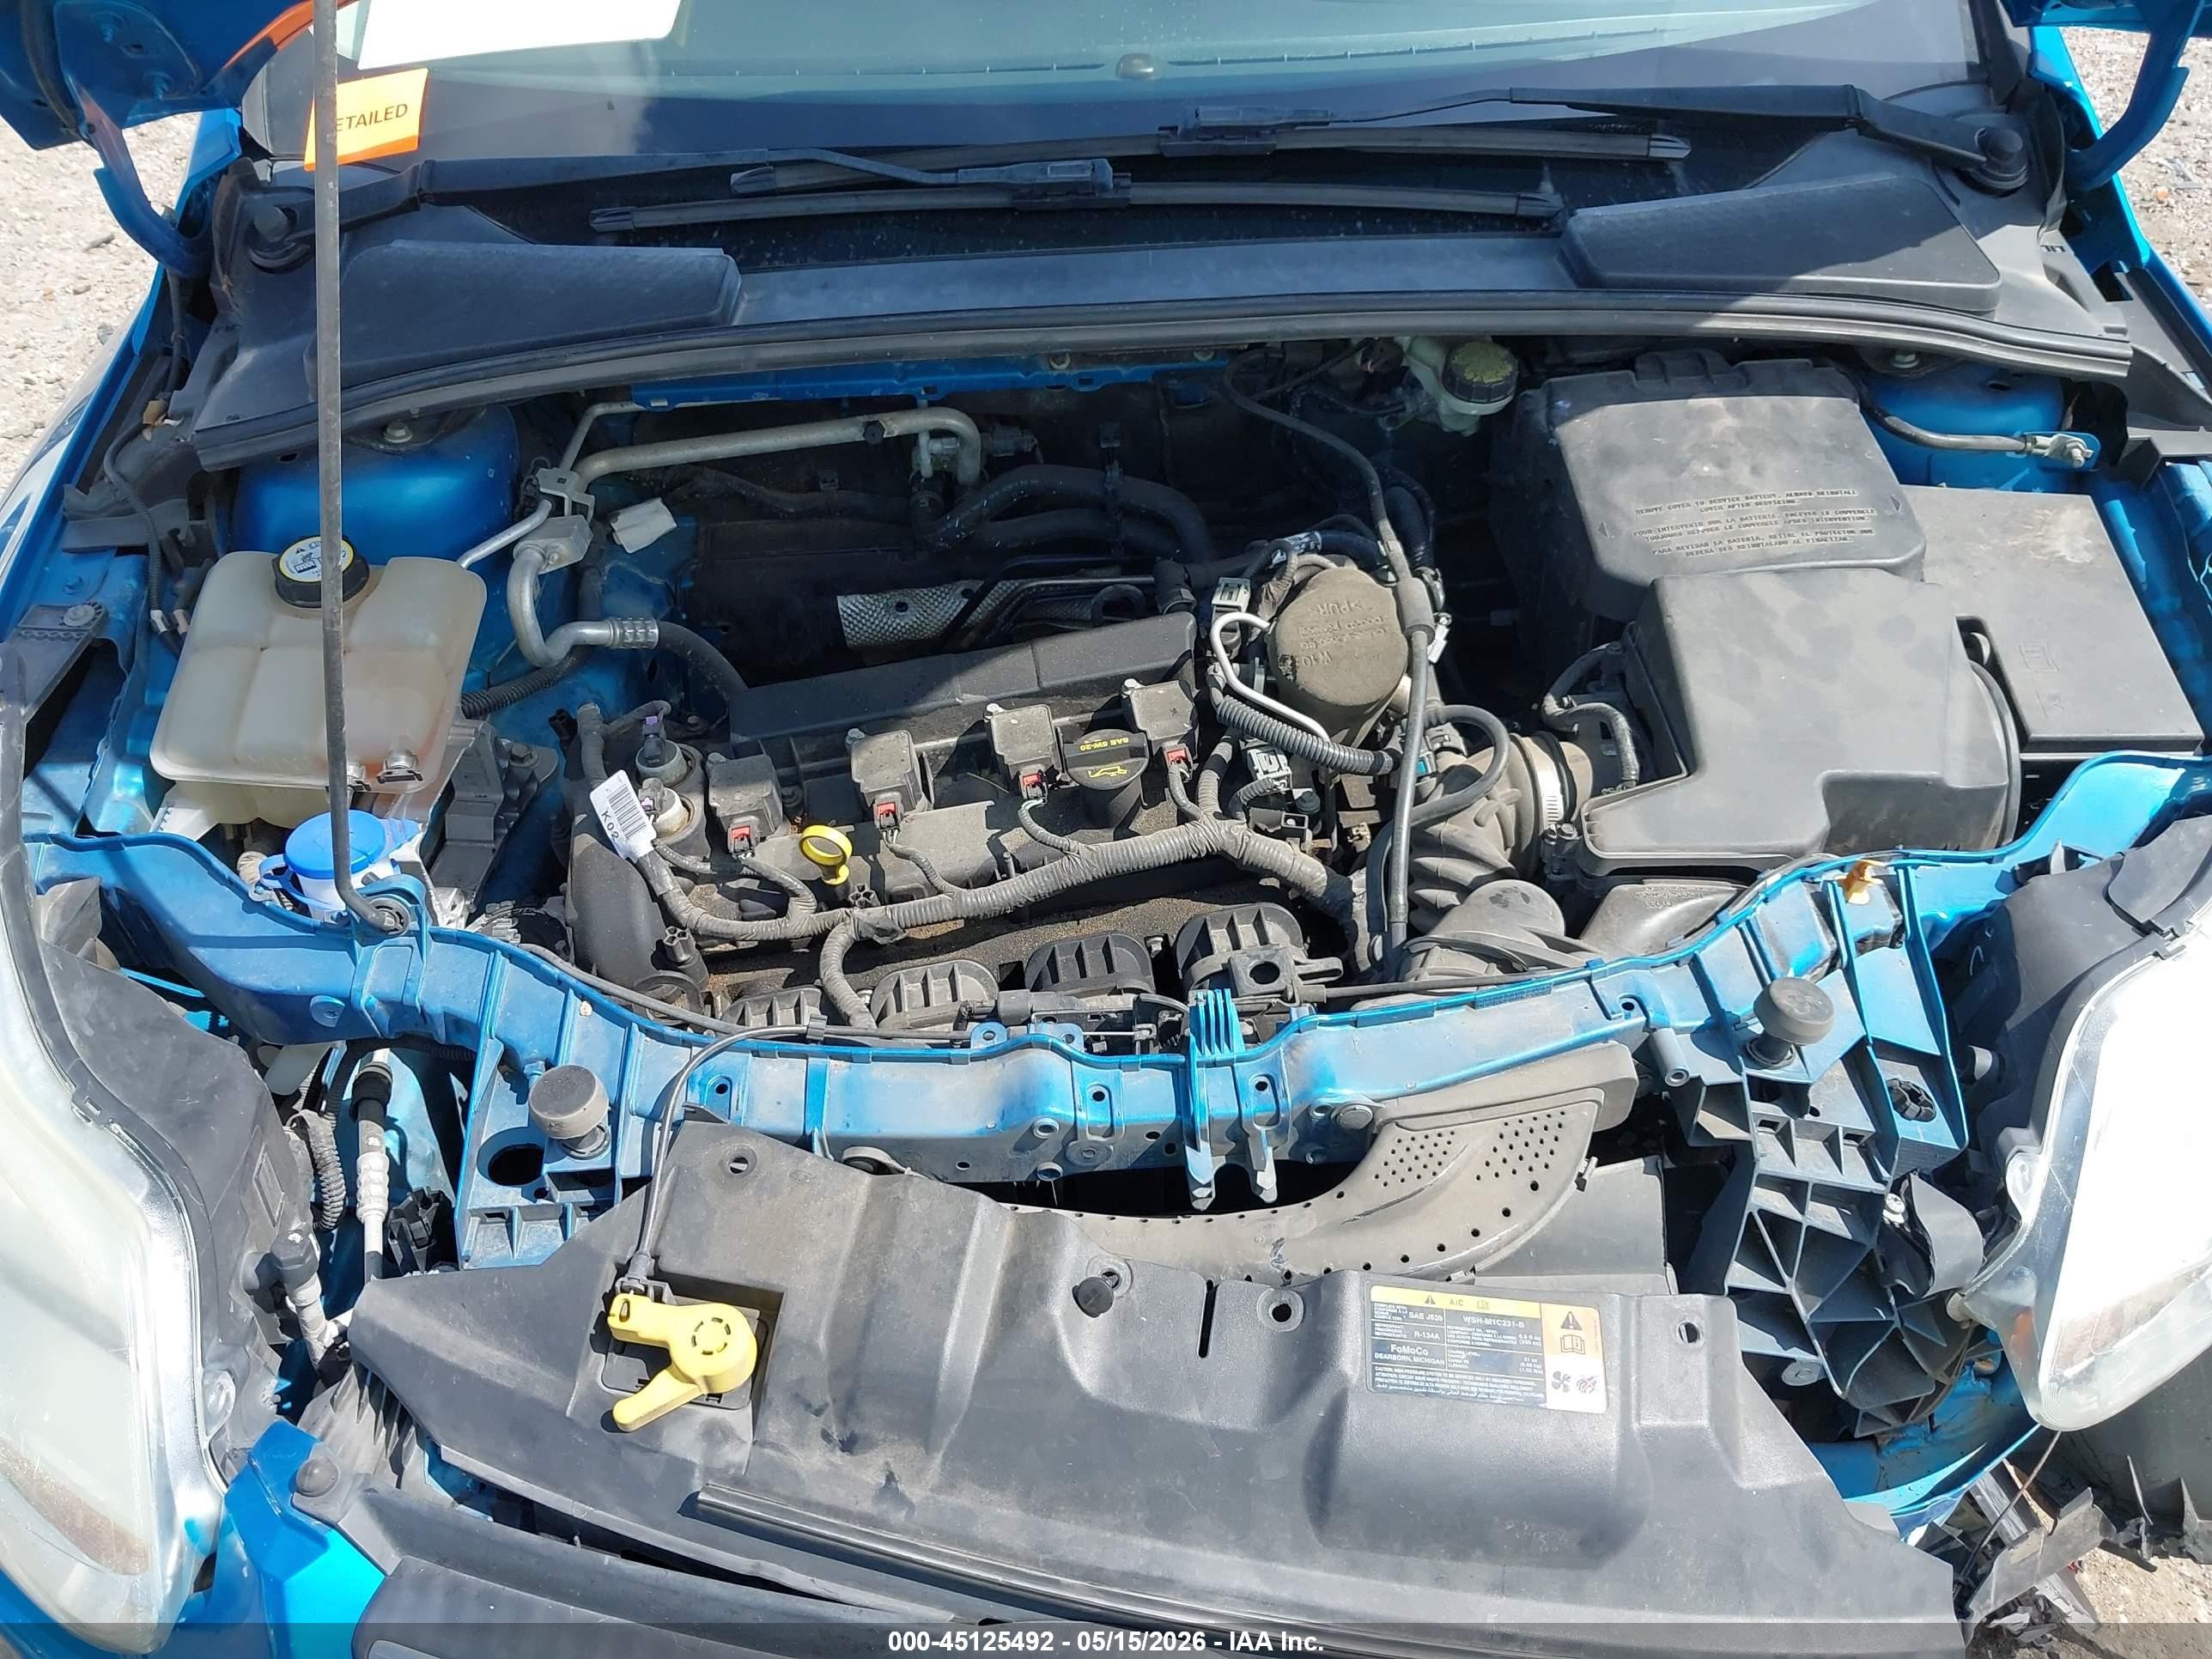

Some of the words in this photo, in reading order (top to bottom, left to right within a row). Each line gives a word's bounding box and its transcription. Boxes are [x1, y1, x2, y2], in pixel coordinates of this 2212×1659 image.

[336, 103, 409, 131] ETAILED
[1635, 505, 1663, 515] REMOVE
[1709, 496, 1740, 505] SERVICE
[1633, 528, 1653, 537] POUR
[1079, 742, 1108, 750] 5W-20
[1110, 738, 1128, 746] SAE
[601, 810, 619, 842] K02
[1449, 1297, 1464, 1306] A/C
[1408, 1311, 1424, 1320] SAE
[1462, 1315, 1525, 1328] WSH-M1C231-B
[1413, 1331, 1440, 1340] R-134A
[1390, 1345, 1429, 1356] FoMoCo
[1374, 1352, 1413, 1362] DEARBORN,
[1413, 1355, 1445, 1365] MICHIGAN
